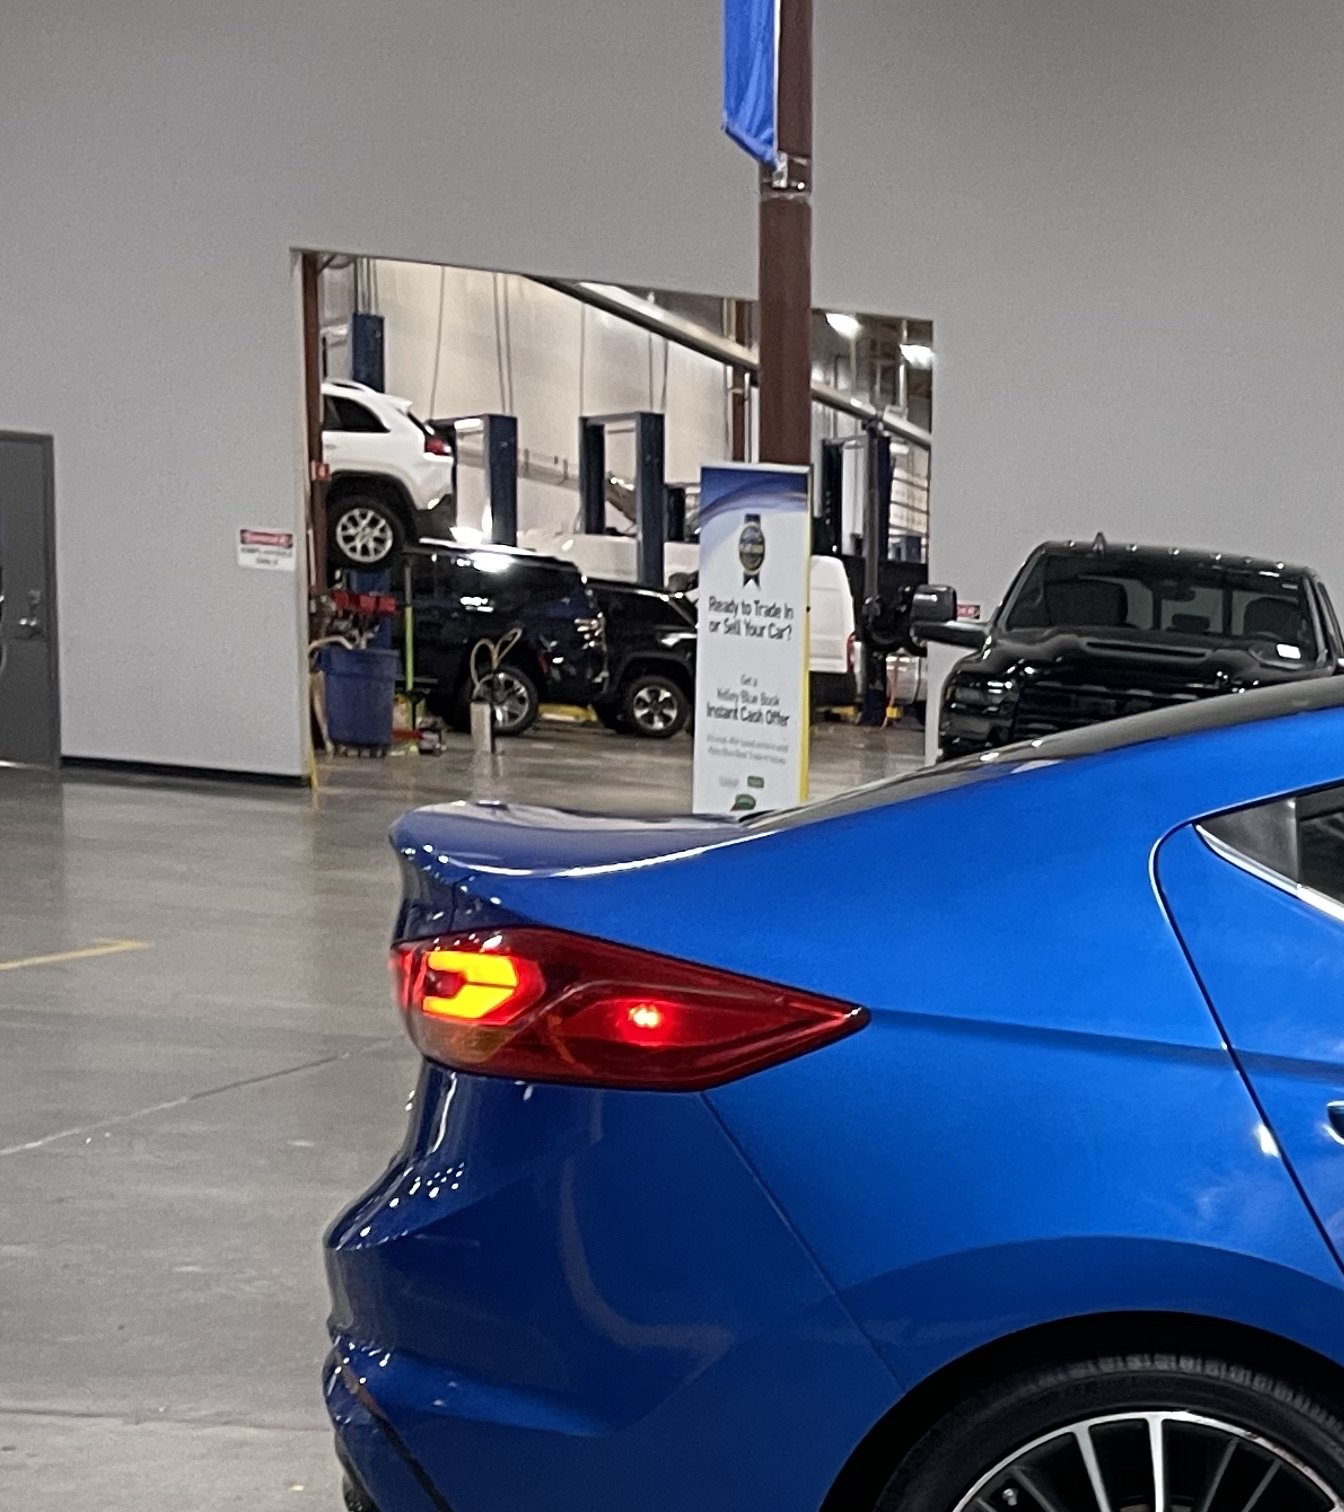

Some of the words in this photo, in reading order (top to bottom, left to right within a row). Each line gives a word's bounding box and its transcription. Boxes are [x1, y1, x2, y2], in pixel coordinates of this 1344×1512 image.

[709, 595, 738, 617] Ready
[742, 599, 752, 616] to
[754, 599, 782, 618] Trade
[784, 603, 794, 620] In
[709, 621, 721, 633] or
[723, 618, 741, 636] Sell
[744, 621, 766, 638] Your
[768, 622, 792, 642] Car?
[707, 701, 738, 720] Instant
[740, 706, 763, 723] Cash
[765, 709, 790, 728] Offer
